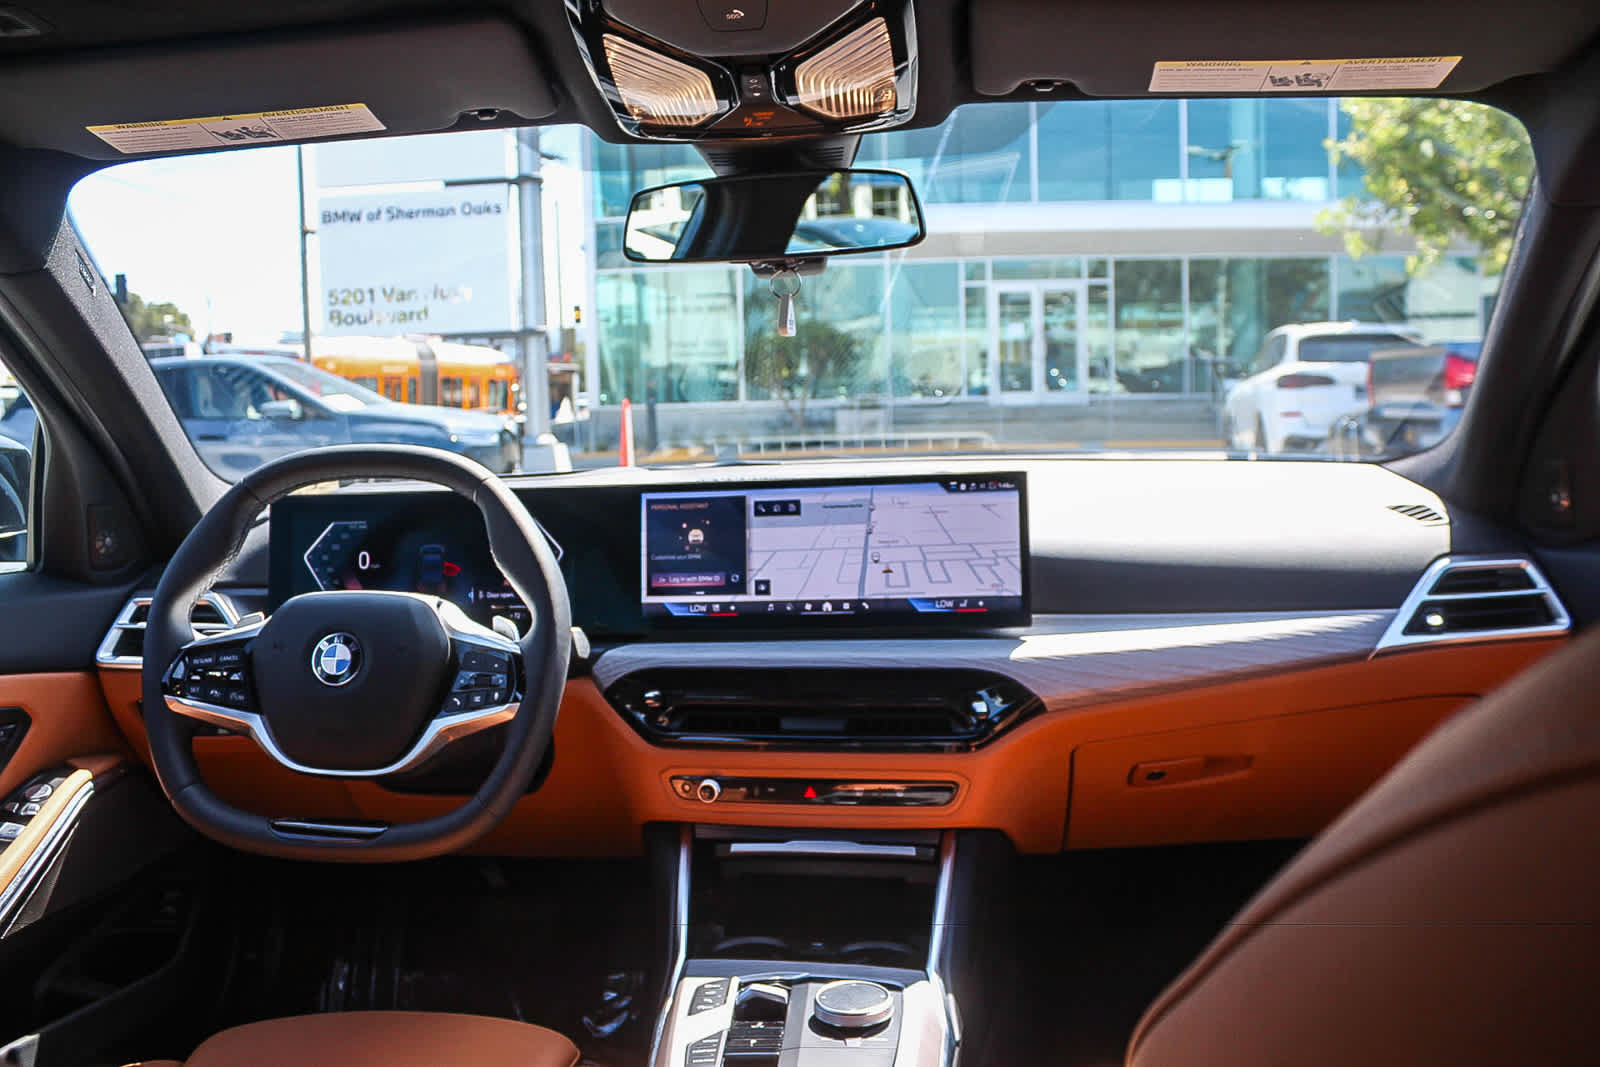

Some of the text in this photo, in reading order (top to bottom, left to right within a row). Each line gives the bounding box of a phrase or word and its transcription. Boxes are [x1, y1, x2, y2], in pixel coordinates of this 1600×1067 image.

[322, 201, 502, 225] BMW of Sherman Oaks
[327, 287, 376, 306] 5201
[359, 551, 370, 570] 0
[689, 603, 708, 613] LOW
[935, 599, 954, 609] LOW
